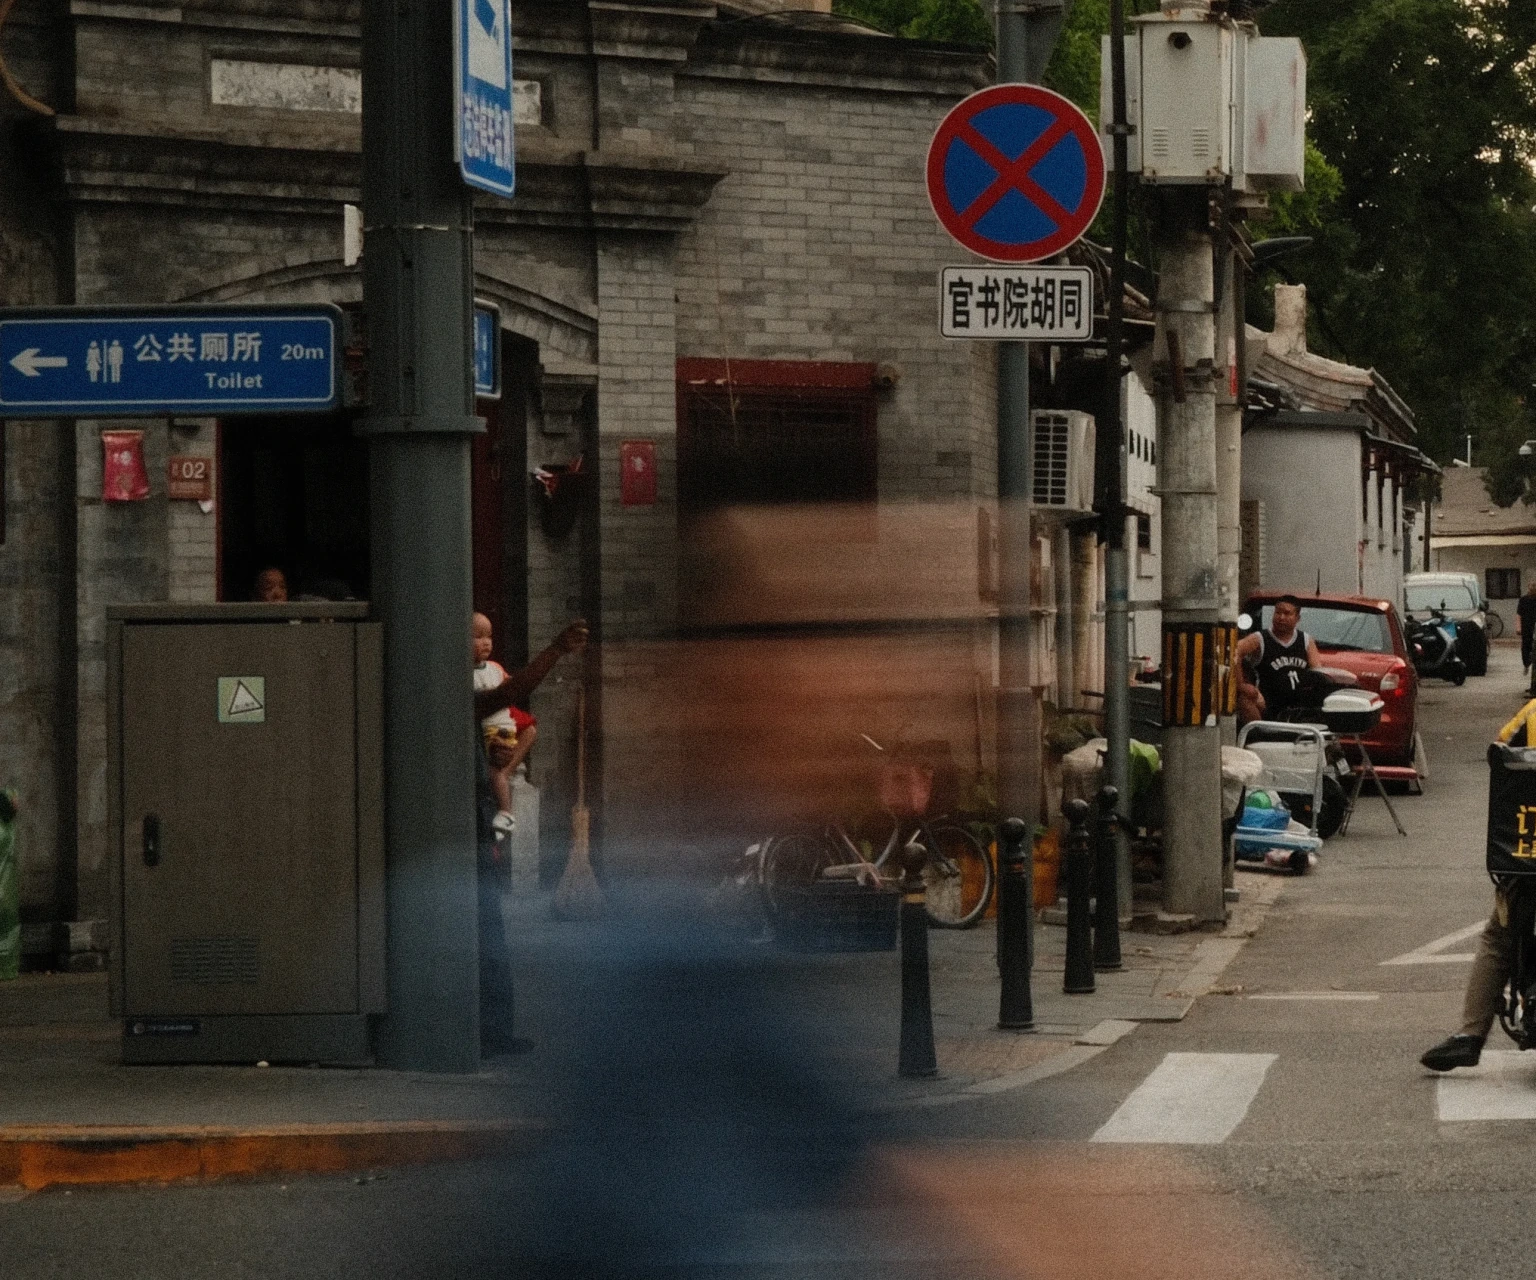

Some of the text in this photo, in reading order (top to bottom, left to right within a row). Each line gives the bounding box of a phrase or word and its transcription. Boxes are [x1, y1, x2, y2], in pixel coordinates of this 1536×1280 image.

[948, 275, 1083, 331] 官书院胡同
[132, 332, 325, 363] 公共厕所 20m
[204, 372, 263, 389] Toilet
